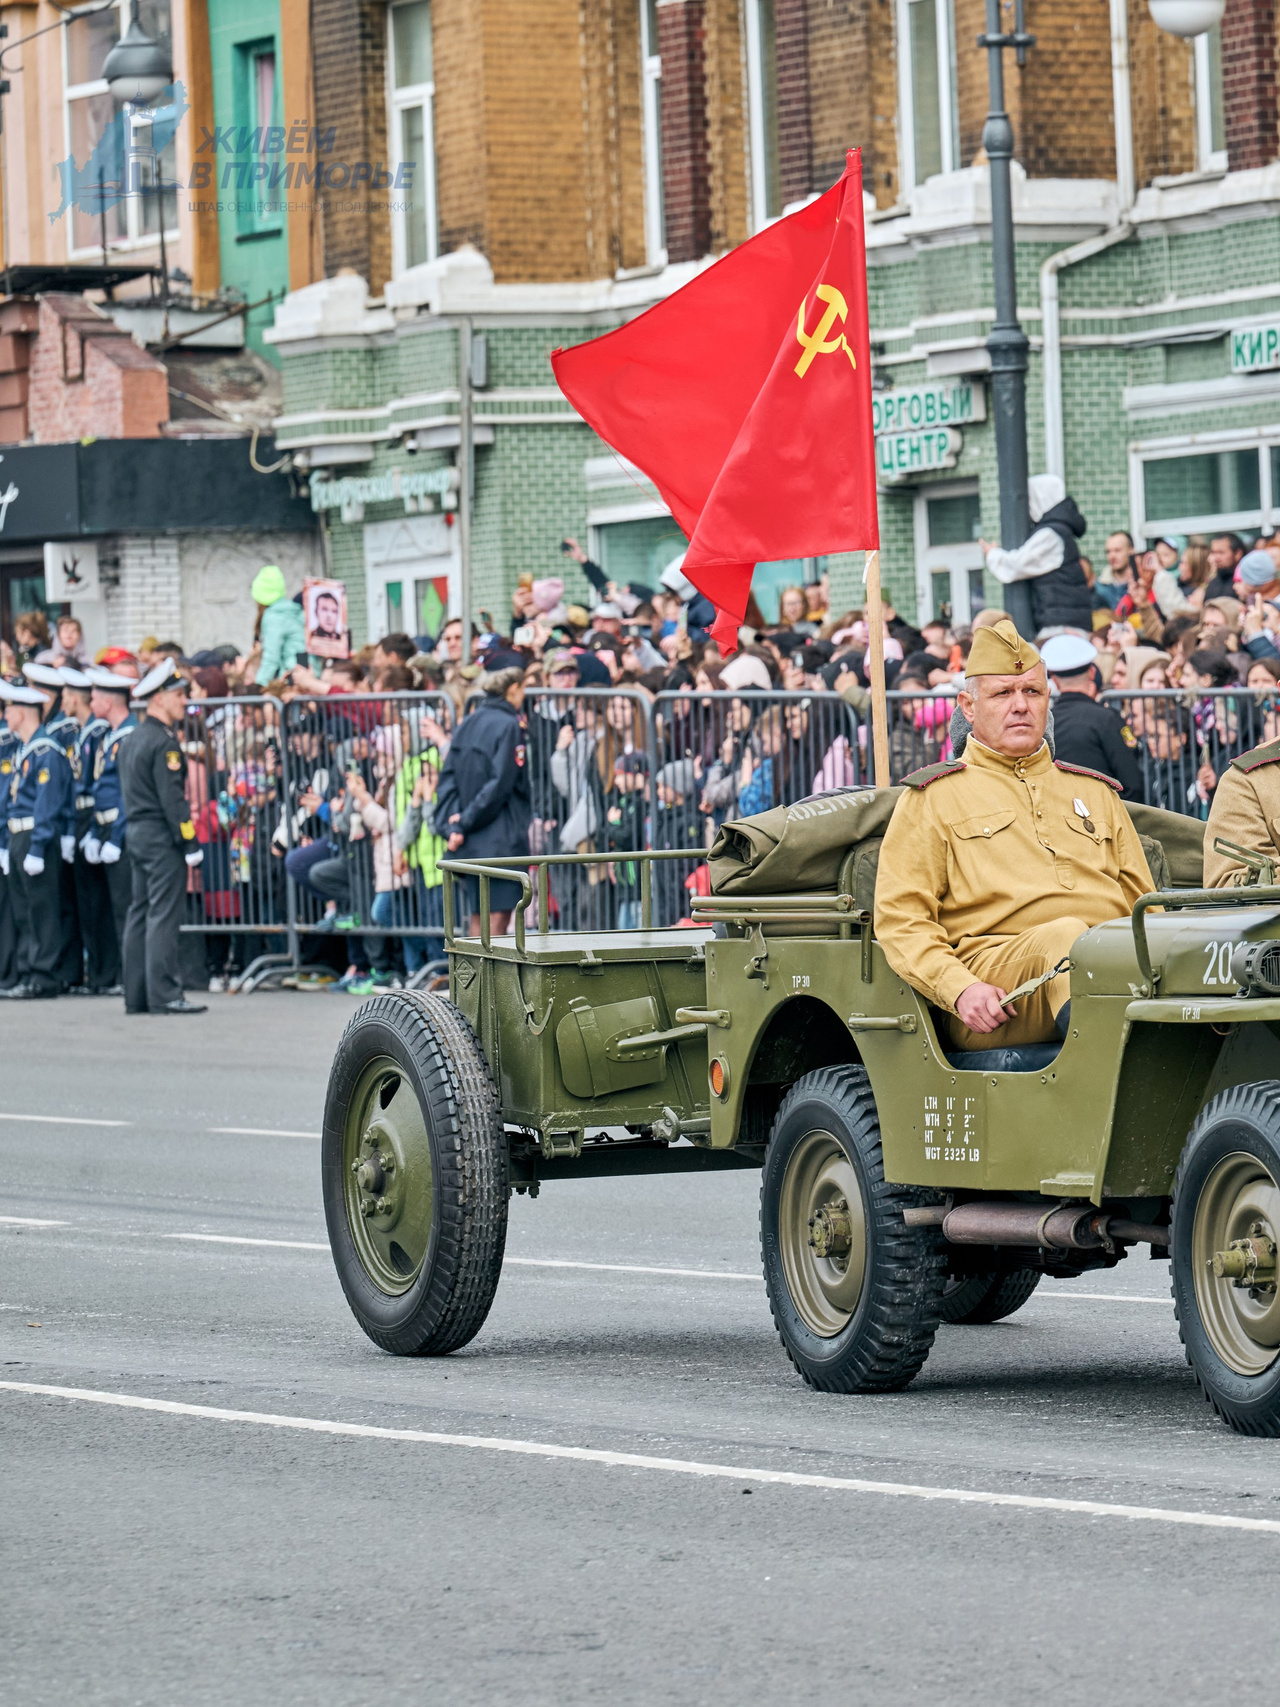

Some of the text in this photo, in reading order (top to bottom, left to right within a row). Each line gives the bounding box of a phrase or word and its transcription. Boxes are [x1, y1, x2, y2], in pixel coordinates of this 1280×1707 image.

[872, 383, 973, 431] ОРГОВЫЙ
[879, 432, 949, 473] ЦЕНТР
[924, 1096, 938, 1110] LTH
[924, 1113, 940, 1127] WTH
[924, 1130, 934, 1143] HT
[924, 1146, 980, 1162] WGT 2325 LB
